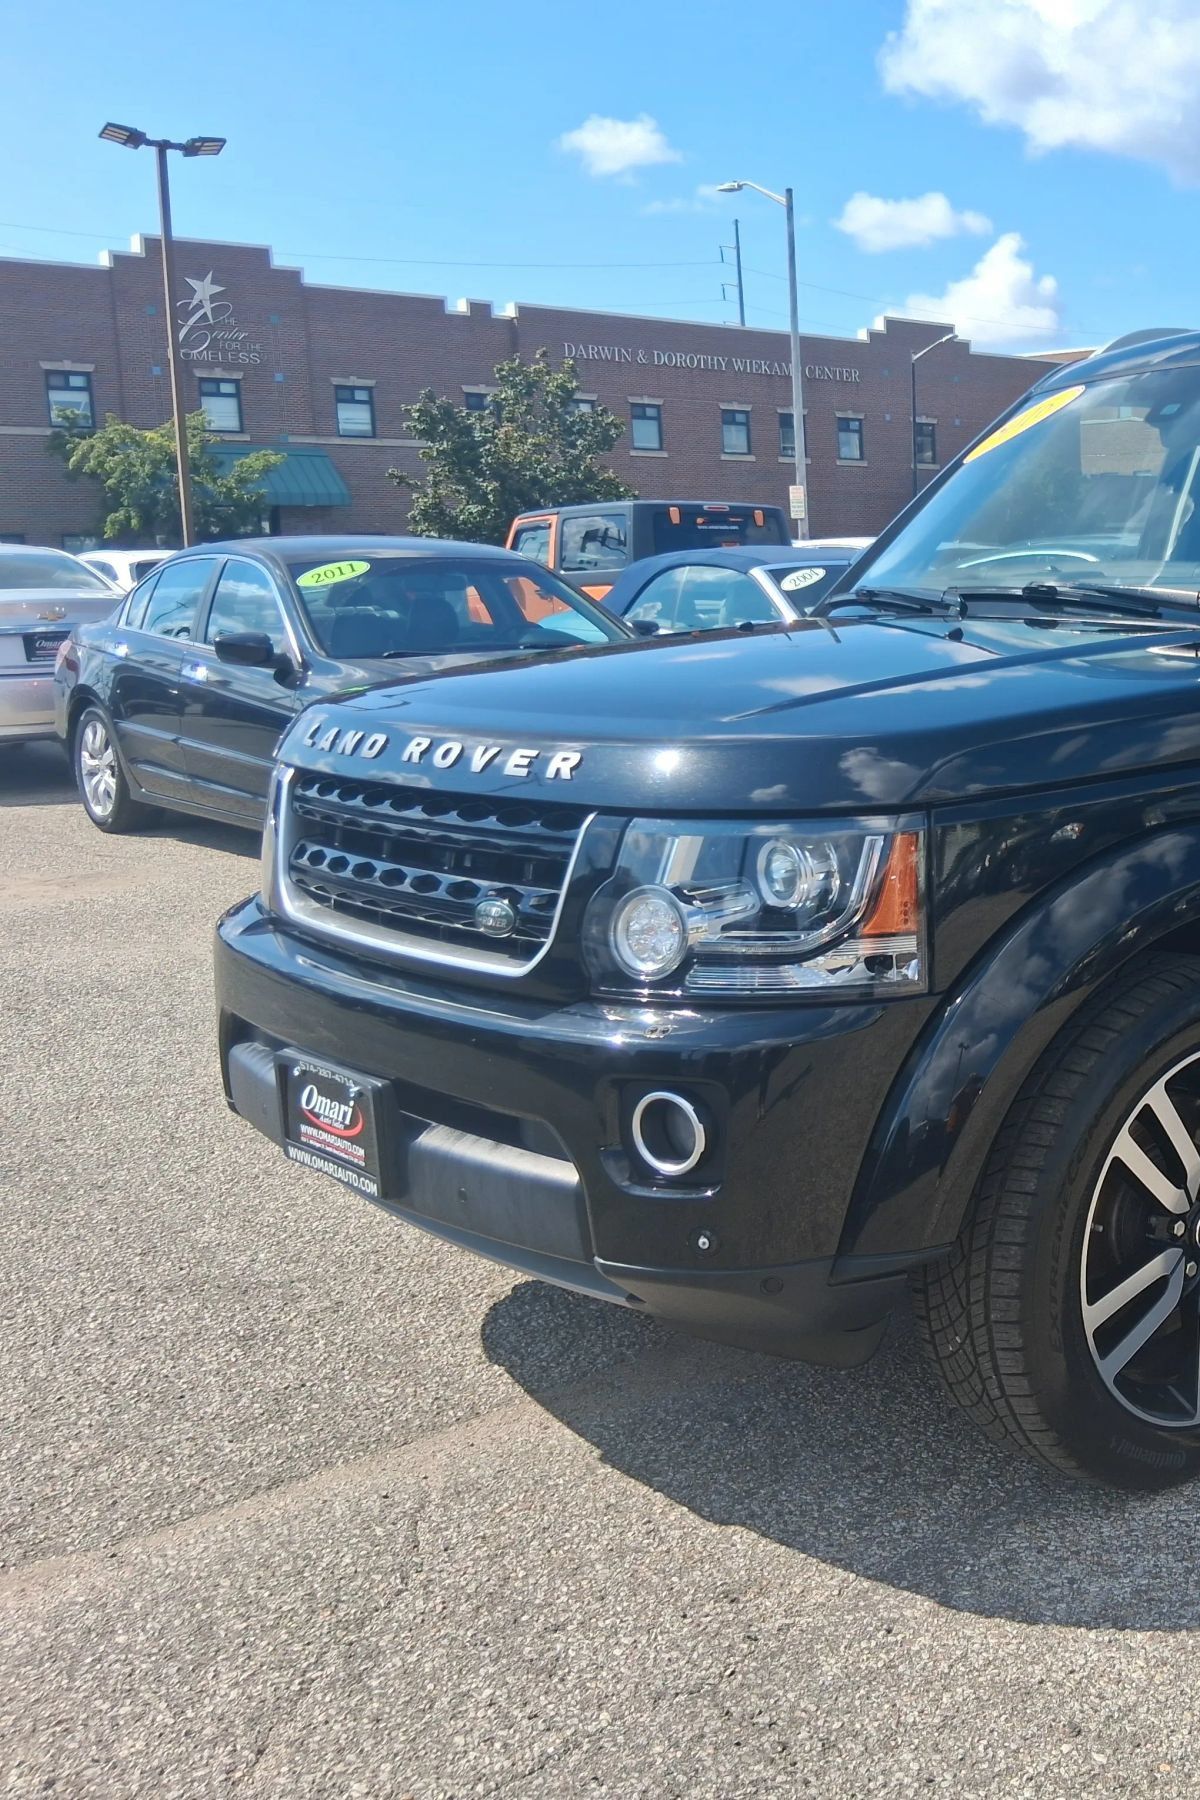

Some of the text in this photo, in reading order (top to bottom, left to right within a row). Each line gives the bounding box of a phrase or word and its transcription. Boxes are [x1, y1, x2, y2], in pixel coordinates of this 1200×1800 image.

[172, 348, 261, 365] OMELESS
[220, 341, 241, 350] FOR
[563, 342, 860, 382] DARWIN & DOROTHY WIEKAM CENTER
[311, 563, 357, 584] 2011
[36, 640, 63, 648] Omar
[302, 723, 583, 780] LAND ROVER
[302, 1085, 354, 1126] Omari
[288, 1146, 378, 1197] WWW.OMARIAUTO.COM
